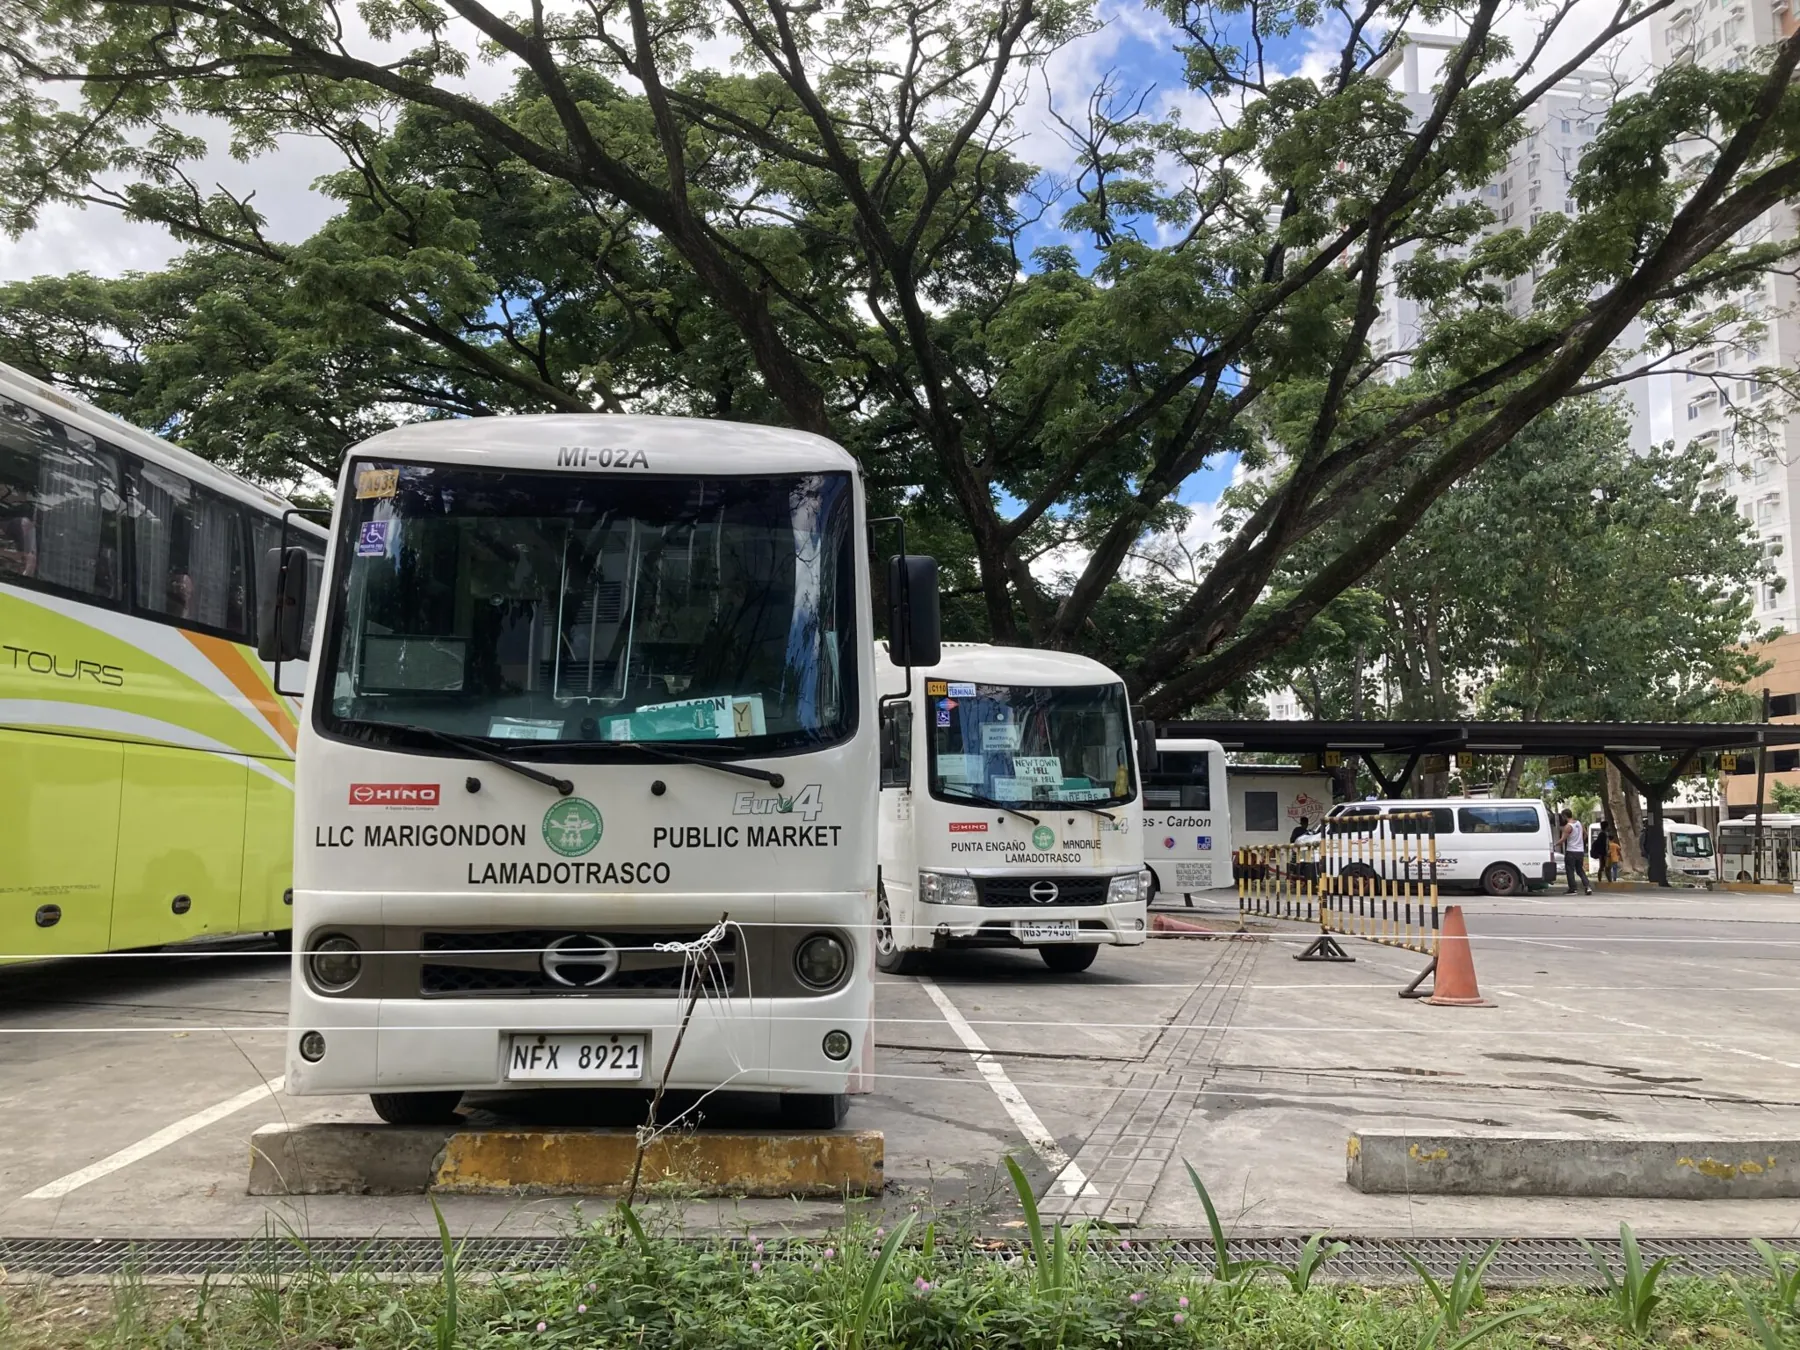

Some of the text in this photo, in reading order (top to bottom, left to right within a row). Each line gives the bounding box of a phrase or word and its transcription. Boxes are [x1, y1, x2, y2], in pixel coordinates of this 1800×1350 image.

[557, 446, 650, 469] MI-02A
[2, 645, 124, 687] TOURS
[1328, 752, 1339, 764] 11
[1459, 753, 1471, 764] 12
[1592, 753, 1604, 765] 13
[1722, 755, 1734, 766] 14
[376, 787, 436, 800] HINO
[1166, 815, 1212, 827] Carbon
[315, 824, 526, 847] LLC MARIGONDON
[653, 825, 842, 848] PUBLIC MARKET
[951, 839, 1026, 852] PUNTA ENGAÑO
[1062, 840, 1101, 850] MANDAUE
[1005, 853, 1081, 864] LAMADOTRASCO
[467, 862, 671, 884] LAMADOTRASCO
[513, 1045, 639, 1069] NFX 8921
